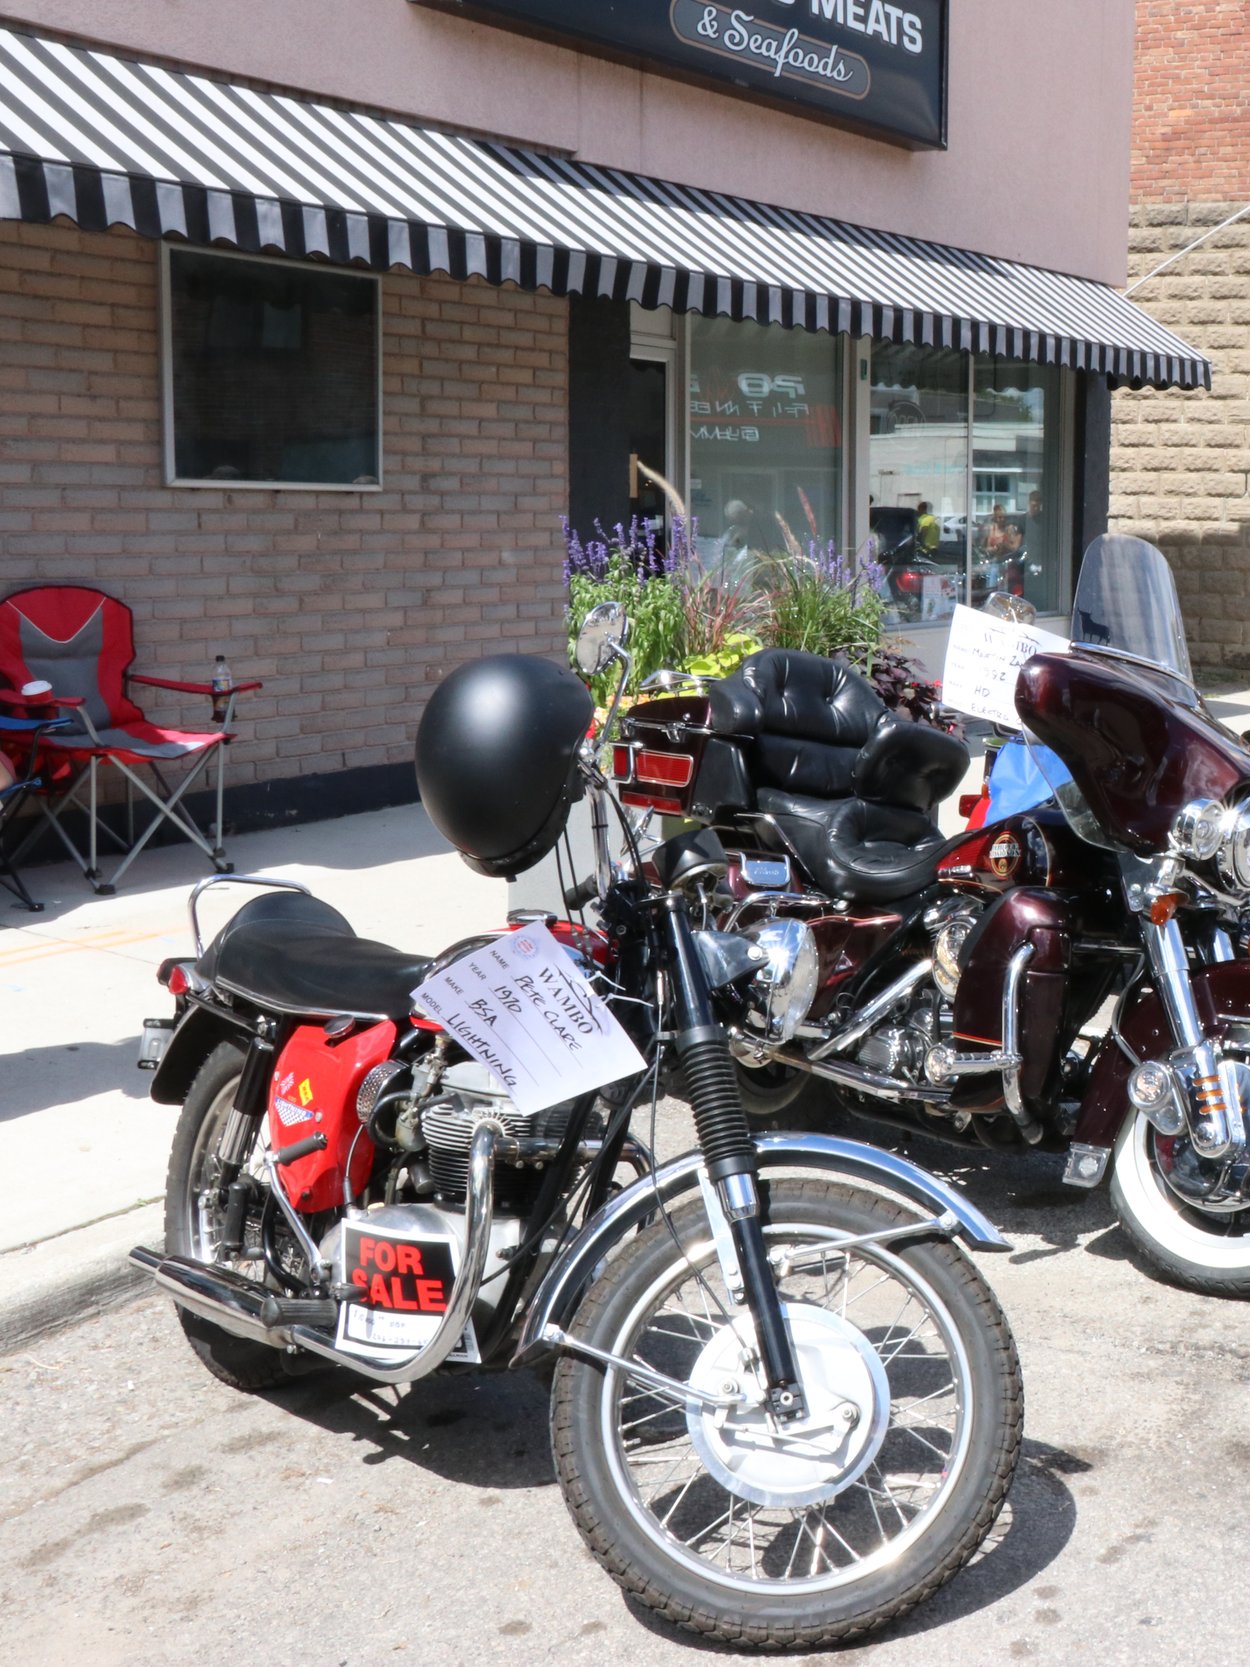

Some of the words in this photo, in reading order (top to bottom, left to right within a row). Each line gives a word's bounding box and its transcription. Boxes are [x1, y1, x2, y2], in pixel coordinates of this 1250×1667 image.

[697, 6, 720, 38] &
[722, 10, 854, 83] Seafoods
[810, 0, 923, 54] MEATS
[489, 950, 510, 970] NAME
[444, 976, 465, 996] MAKE
[468, 998, 498, 1028] BSA
[468, 961, 488, 981] YEAR
[493, 984, 523, 1015] 1970
[538, 966, 594, 1035] WAMBO
[420, 991, 443, 1014] MODEL
[446, 1012, 518, 1089] LIGHTNING
[359, 1236, 424, 1275] FOR
[352, 1267, 448, 1312] SALE
